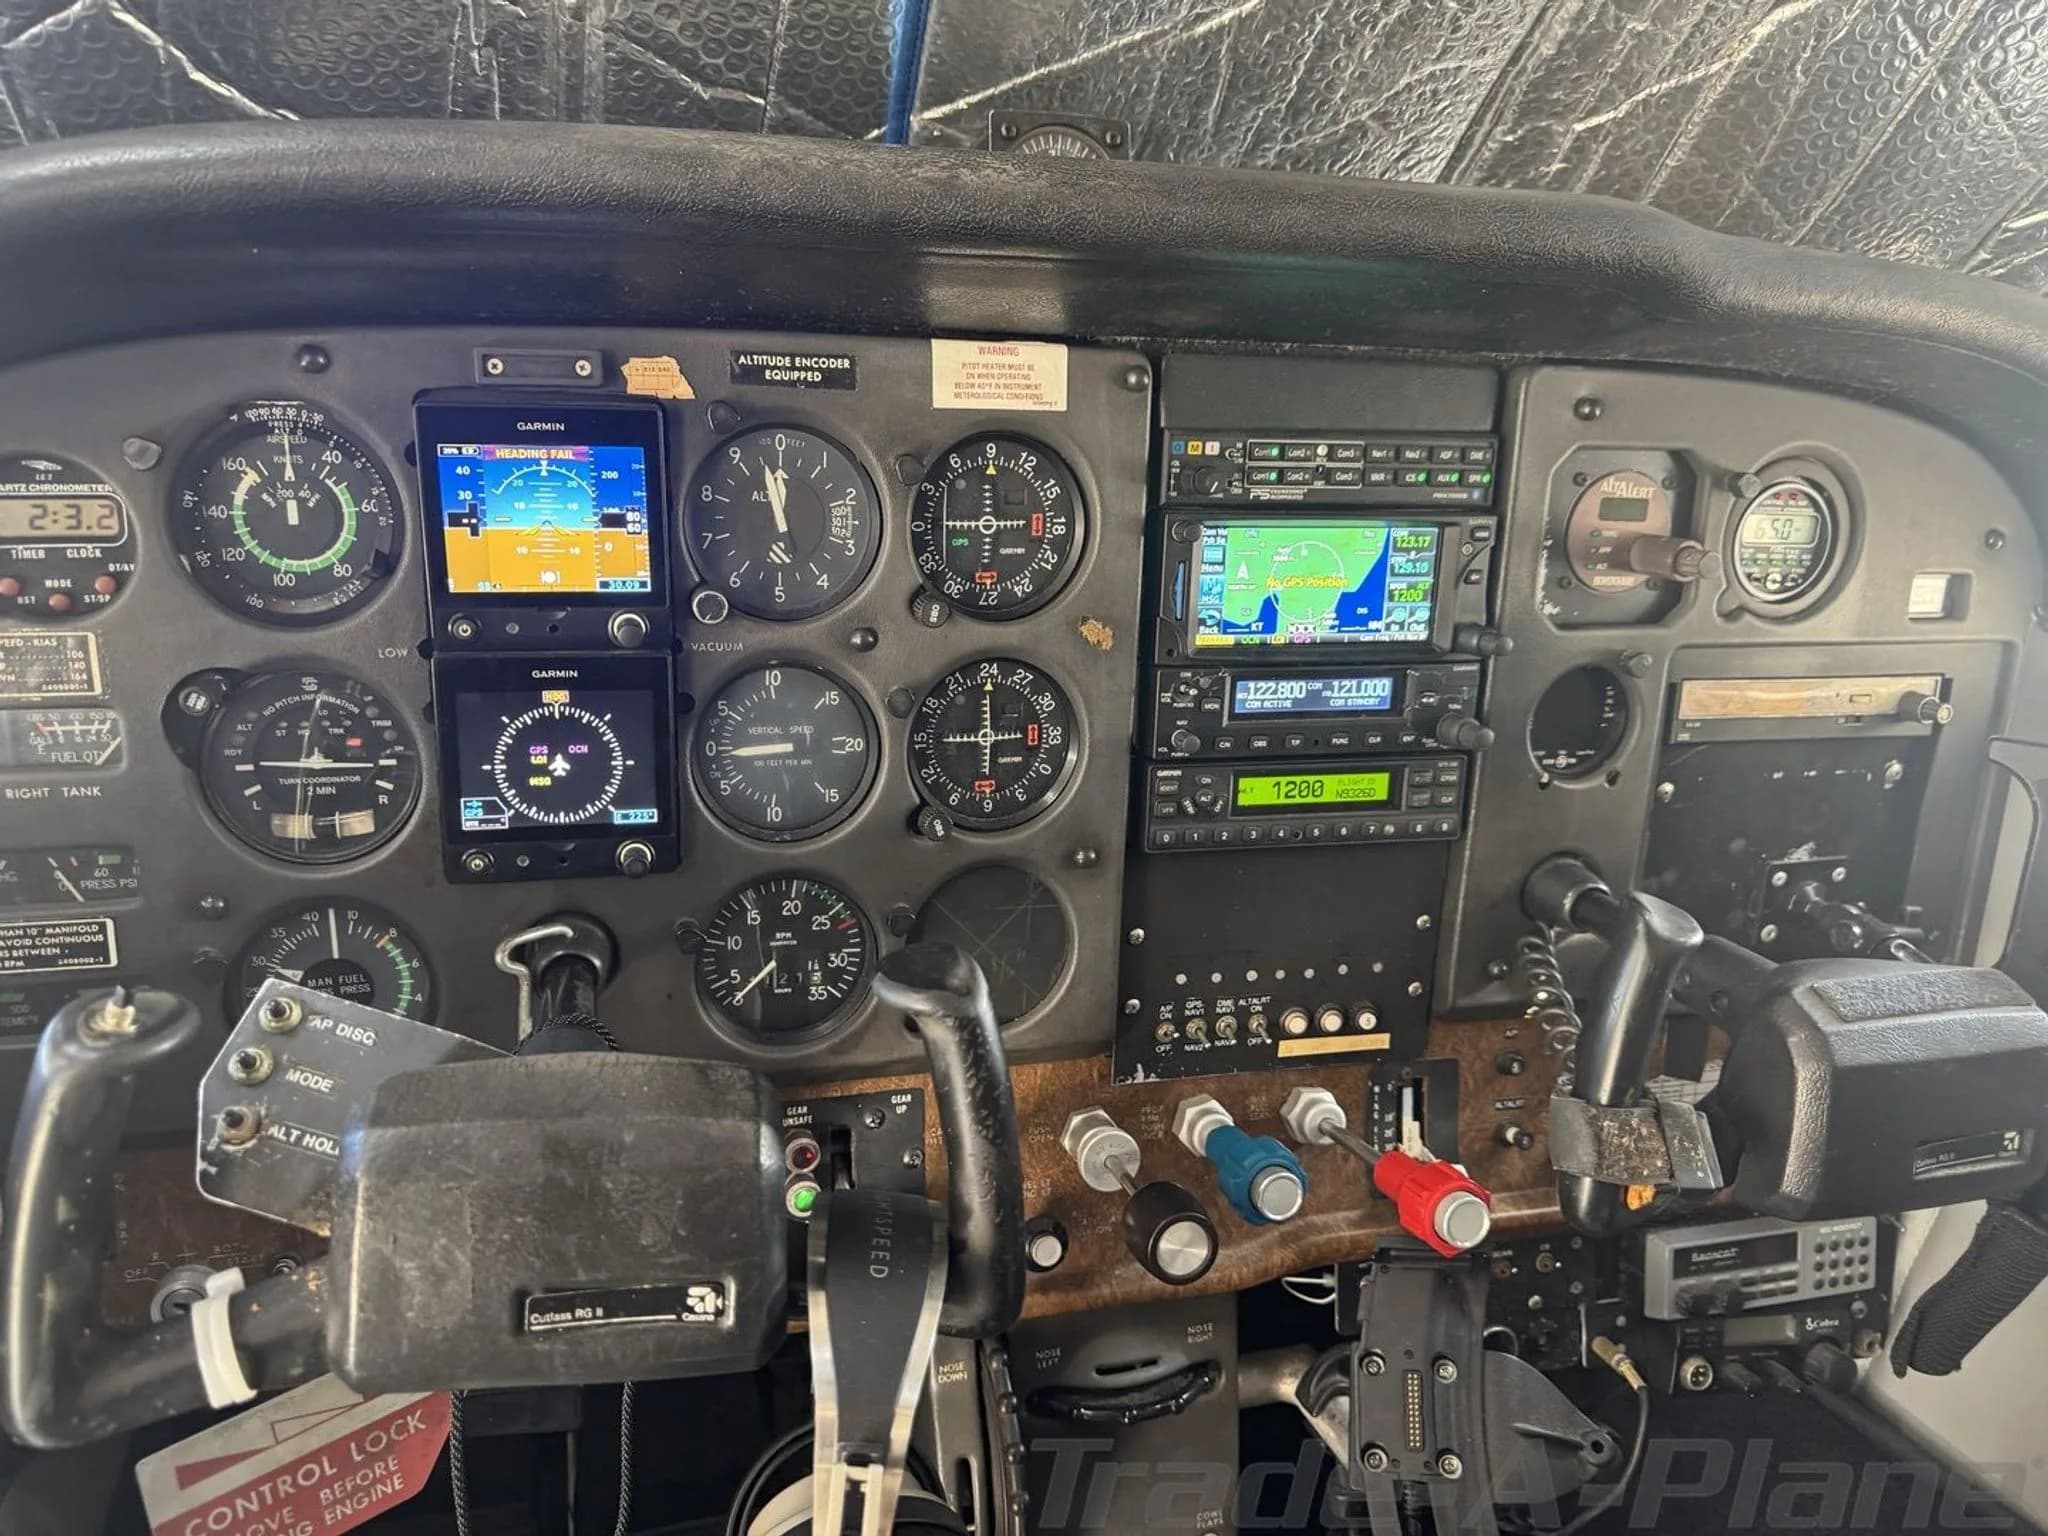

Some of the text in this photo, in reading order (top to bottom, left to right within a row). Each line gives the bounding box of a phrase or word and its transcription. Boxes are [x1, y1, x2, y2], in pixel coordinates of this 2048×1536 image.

[978, 346, 1020, 357] WARNING
[738, 354, 850, 369] ALTITUDE ENCODER
[961, 363, 980, 372] PITOT
[981, 363, 1006, 372] HEATER
[1008, 364, 1026, 372] MUST
[765, 369, 822, 382] EQUIPPED
[966, 372, 1032, 381] ON WHEN OPERATING
[954, 382, 976, 390] BELOW
[1002, 382, 1043, 391] INSTRUMENT
[1006, 392, 1044, 401] CONDITIONS
[516, 421, 566, 432] GARMIN
[321, 450, 342, 464] 40
[495, 449, 575, 461] HEADING FAIL
[222, 457, 247, 471] 160
[456, 465, 471, 476] 40
[600, 470, 619, 481] 200
[29, 483, 113, 493] CHRONOMETER
[457, 490, 473, 501] 30
[361, 498, 379, 513] 60
[951, 537, 970, 547] GPS
[1396, 536, 1431, 548] 123.17
[11, 549, 46, 560] TIMER
[66, 549, 103, 559] CLOCK
[222, 548, 246, 562] 120
[333, 564, 353, 578] 80
[1200, 564, 1224, 573] Menu
[44, 578, 73, 588] MODE
[273, 573, 296, 587] 100
[607, 580, 641, 591] 30.09
[1283, 576, 1304, 588] GPS
[1306, 576, 1348, 588] Position
[83, 594, 112, 604] ST/SP
[1392, 590, 1423, 602] 1200
[929, 603, 941, 623] OBS
[1199, 625, 1219, 634] Back
[1250, 621, 1264, 632] KT
[33, 638, 58, 647] KIAS
[691, 642, 744, 652] VACUUM
[66, 650, 85, 659] 106
[378, 648, 408, 659] LOW
[531, 669, 578, 678] GARMIN
[765, 670, 782, 686] 10
[1247, 679, 1389, 700] 122.800 121.000
[824, 691, 840, 705] 15
[1329, 698, 1346, 707] COM
[262, 707, 276, 718] NO
[275, 697, 299, 713] PITCH
[1245, 700, 1293, 709] COM ACTIVE
[236, 723, 253, 733] ALT
[371, 719, 393, 728] TRIM
[328, 727, 346, 736] TRK
[748, 725, 815, 735] VERTICAL SPEED
[528, 745, 549, 754] GPS
[844, 737, 864, 752] 20
[51, 752, 79, 763] FUEL
[302, 774, 361, 785] COORDINATOR
[5, 786, 102, 800] RIGHT TANK
[316, 785, 337, 796] MIN
[1272, 779, 1325, 799] 1200
[378, 795, 389, 805] R
[824, 789, 840, 802] 15
[1200, 794, 1212, 802] ALT
[252, 800, 262, 811] L
[464, 807, 484, 817] GPS
[766, 806, 783, 822] 10
[80, 878, 138, 889] PRESS PSI
[782, 899, 802, 916] 20
[747, 909, 761, 925] 15
[811, 915, 831, 931] 25
[45, 924, 99, 935] MANIFOLD
[35, 934, 104, 946] CONTINUOUS
[775, 932, 792, 940] RPM
[727, 935, 743, 951] 10
[12, 947, 60, 957] BETWEEN
[4, 959, 26, 968] RPM
[827, 952, 848, 968] 30
[307, 973, 366, 988] MAN FUEL
[340, 983, 372, 994] PRESS
[808, 985, 828, 1001] 35
[1238, 996, 1271, 1006] ALTALRT
[1184, 1008, 1205, 1017] NAV1
[1216, 1006, 1235, 1014] NAV1
[1250, 1004, 1263, 1012] ON
[1160, 1012, 1172, 1020] ON
[310, 1013, 333, 1031] AP
[1247, 1036, 1263, 1045] OFF
[1155, 1044, 1171, 1053] OFF
[1184, 1043, 1204, 1052] NAV2
[285, 1068, 334, 1094] MODE
[891, 1093, 912, 1104] GEAR
[787, 1105, 808, 1115] GEAR
[896, 1105, 907, 1114] UP
[782, 1114, 813, 1127] UNSAFE
[266, 1122, 301, 1143] ALT
[530, 1306, 603, 1324] Cutlass RG II
[1186, 1322, 1214, 1335] NOSE
[1187, 1331, 1214, 1344] RIGHT
[1035, 1347, 1062, 1360] NOSE
[939, 1360, 967, 1374] NOSE
[1037, 1357, 1060, 1369] LEFT
[937, 1370, 969, 1383] DOWN
[184, 1409, 427, 1536] CONTROL LOCK
[318, 1454, 400, 1506] BEFORE
[323, 1472, 404, 1526] ENGINE
